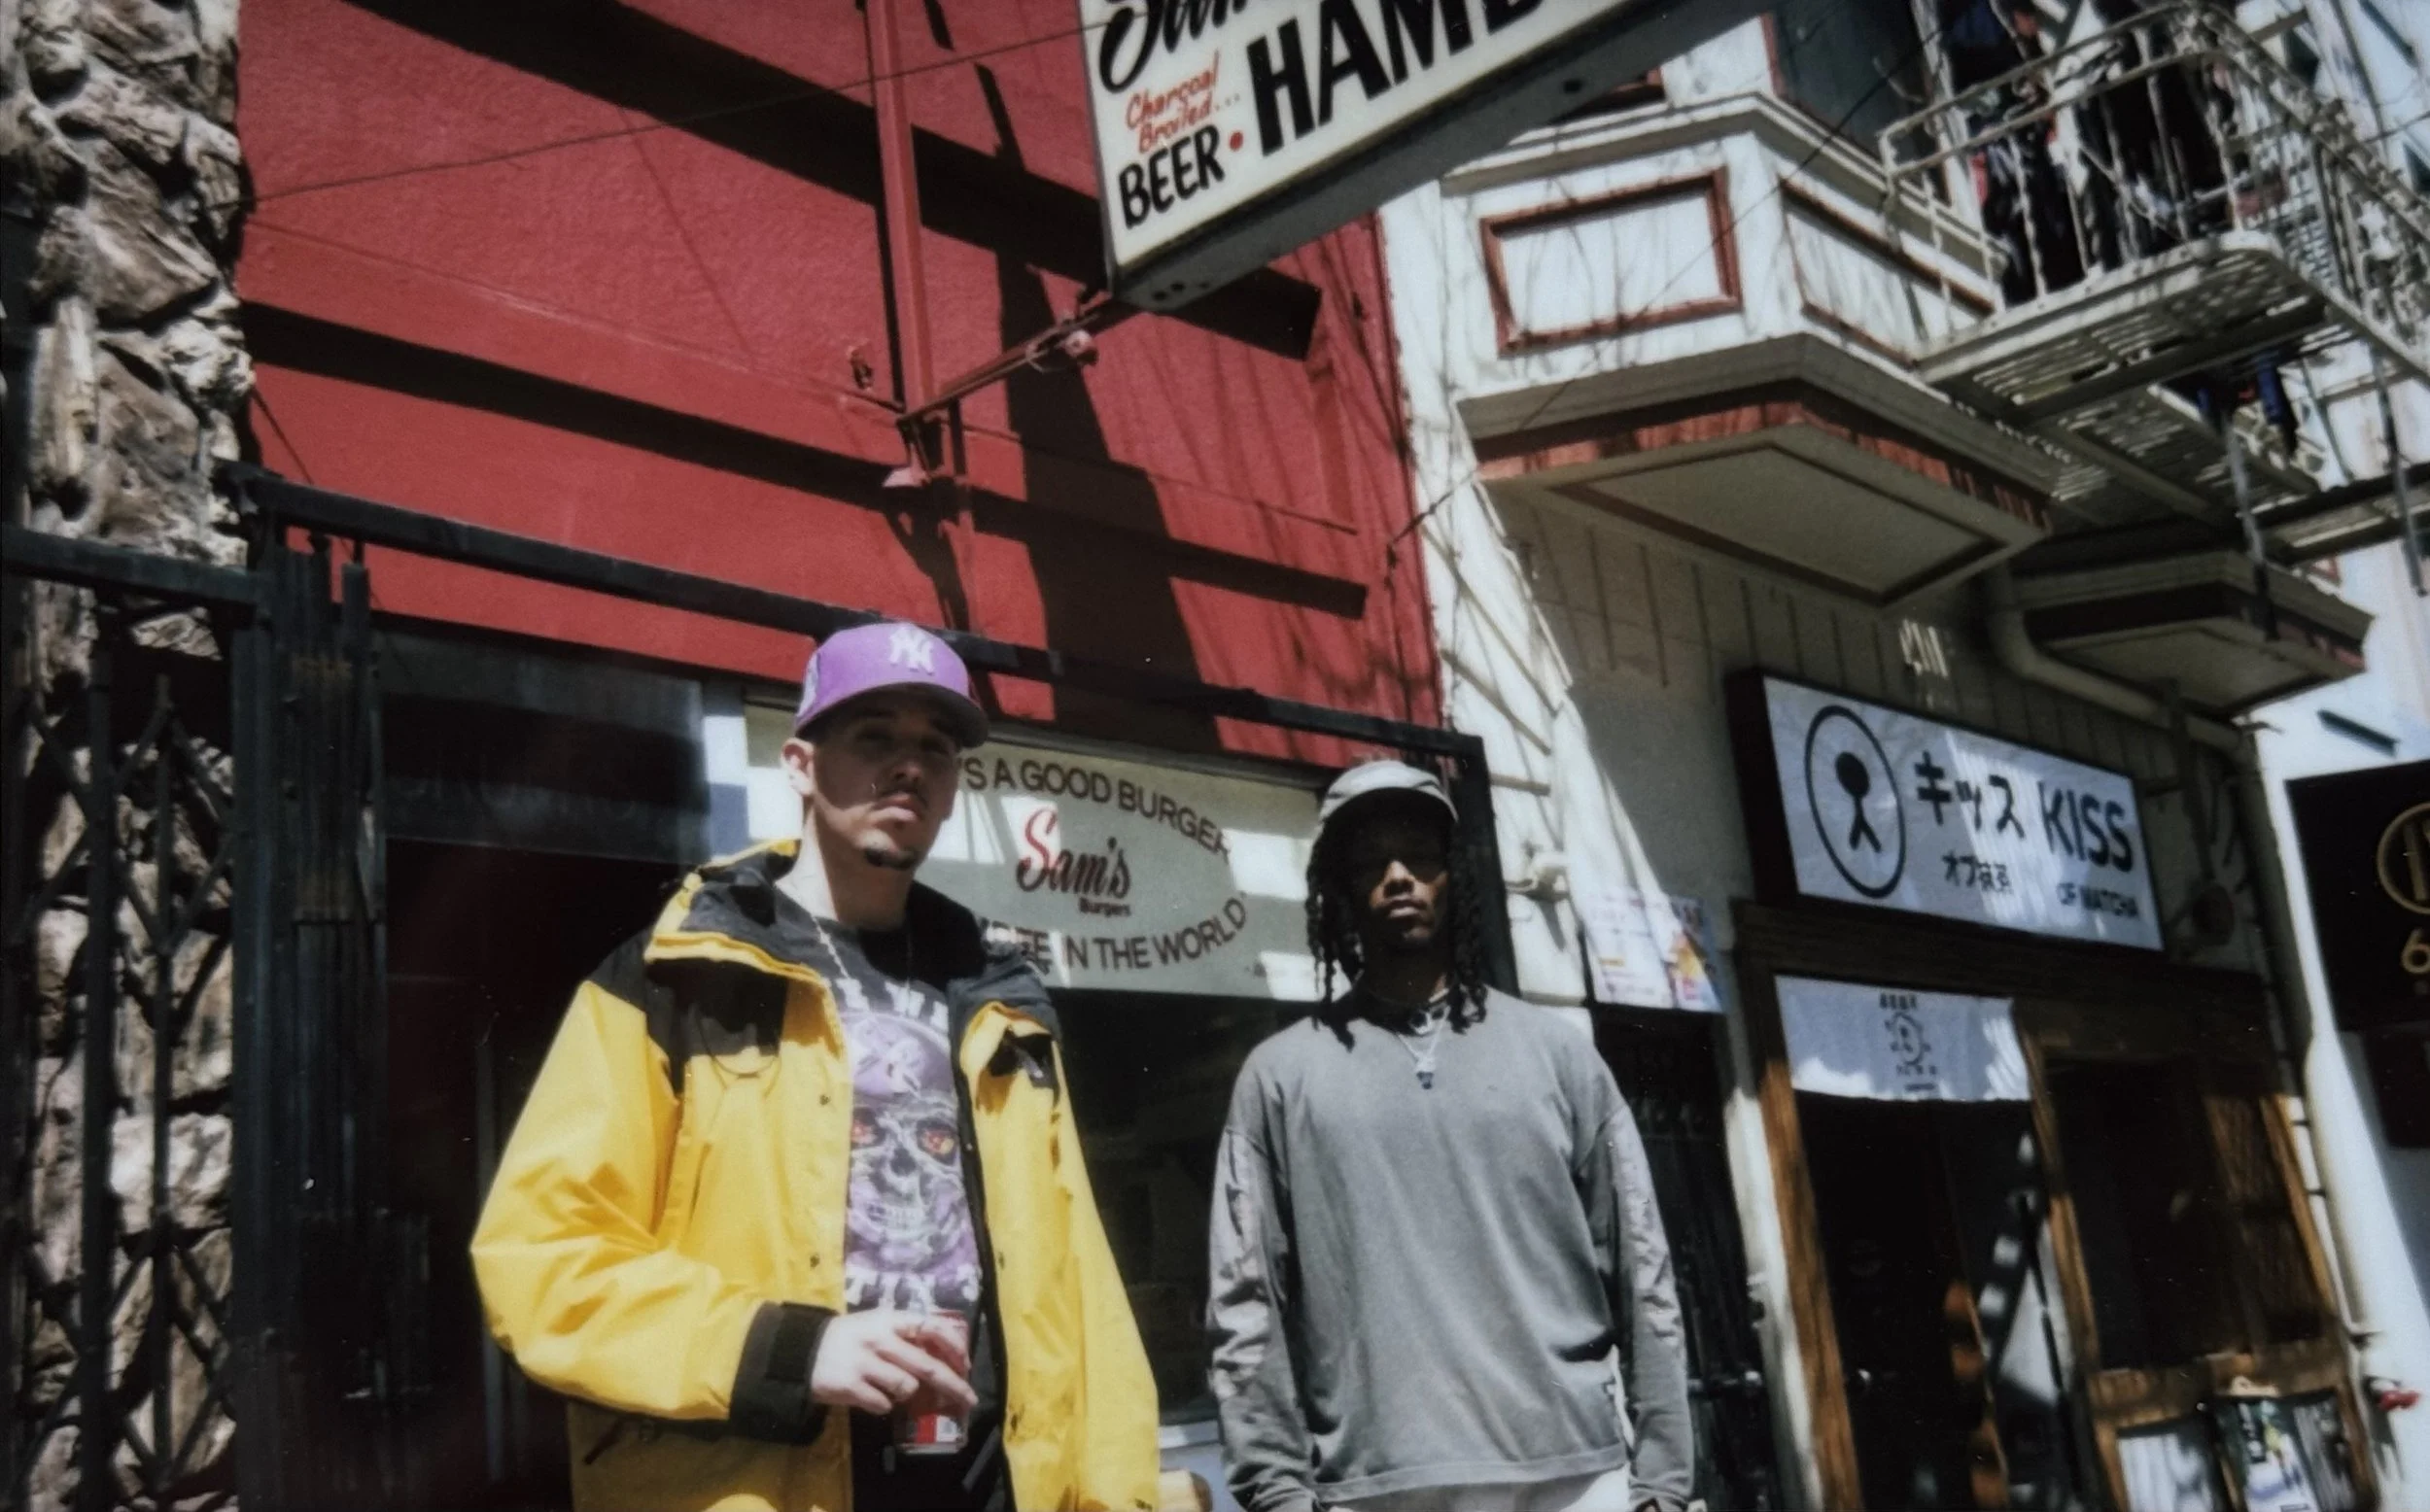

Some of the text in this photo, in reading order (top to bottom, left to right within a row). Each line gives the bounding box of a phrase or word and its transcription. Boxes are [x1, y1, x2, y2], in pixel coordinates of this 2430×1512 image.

[1127, 47, 1219, 130] Charcoal
[1246, 0, 1545, 157] HAM
[1119, 124, 1226, 229] BEER
[993, 758, 1017, 790] A
[1020, 760, 1113, 804] GOOD
[1118, 778, 1230, 865] BURGER
[1914, 749, 2026, 840] キッス
[2037, 779, 2134, 873] KISS
[1016, 807, 1131, 899] Sam's
[1093, 936, 1152, 970] THE
[1151, 896, 1247, 967] WORLD
